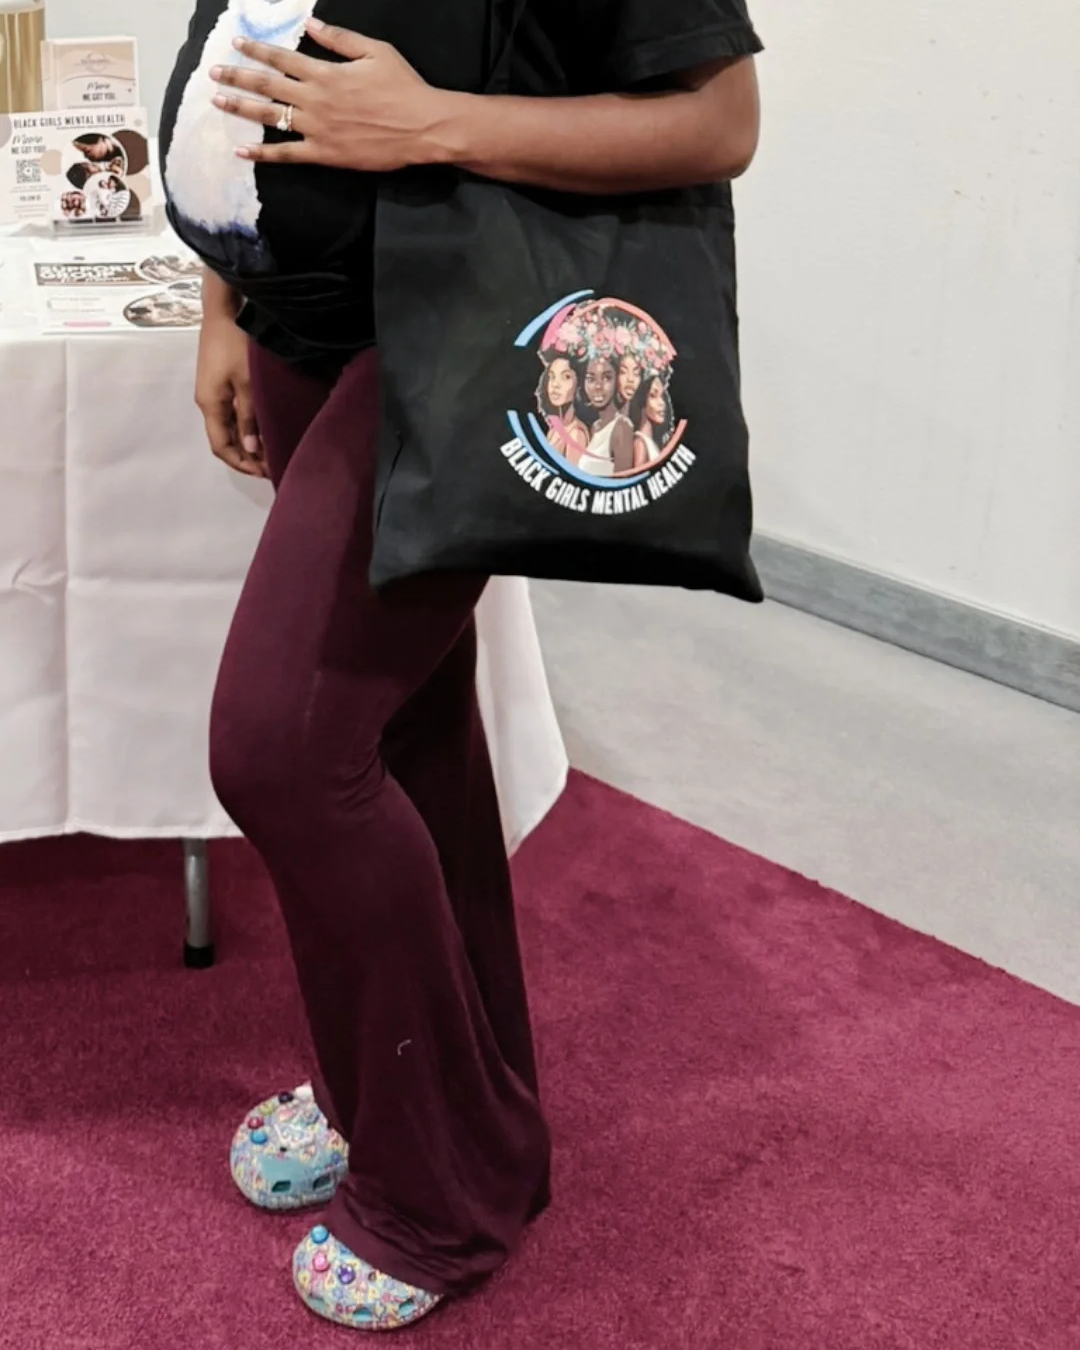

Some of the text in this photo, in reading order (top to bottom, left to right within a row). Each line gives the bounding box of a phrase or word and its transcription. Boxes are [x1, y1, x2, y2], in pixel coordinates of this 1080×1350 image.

[14, 118, 37, 129] BLACK
[40, 117, 61, 128] GIRLS
[64, 115, 94, 126] MENTAL
[97, 113, 125, 124] HEALTH
[500, 437, 697, 515] BLACK GIRLS MENTAL HEALTH
